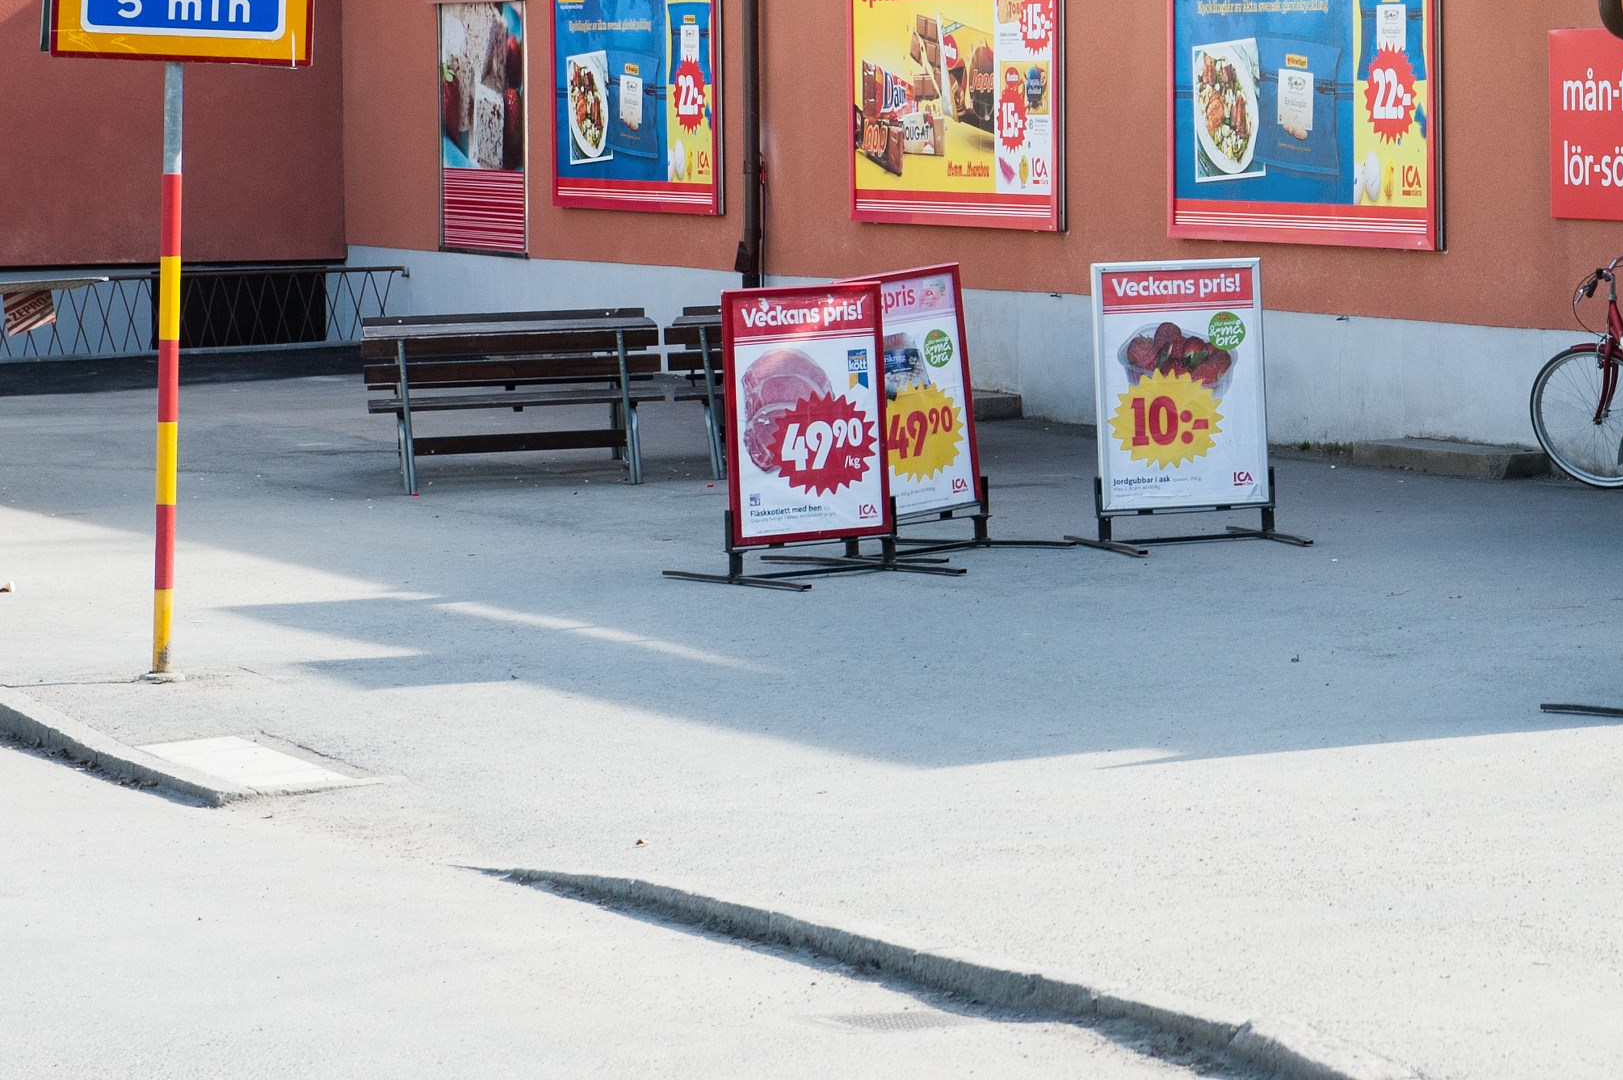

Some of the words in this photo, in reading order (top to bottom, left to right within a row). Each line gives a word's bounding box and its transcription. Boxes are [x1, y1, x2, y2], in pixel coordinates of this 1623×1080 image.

[697, 151, 710, 169] ICA
[1031, 157, 1049, 178] ICA
[1402, 166, 1422, 188] ICA
[1111, 276, 1195, 297] Veckans
[1199, 273, 1241, 298] pris!
[881, 284, 916, 314] pris
[741, 305, 821, 328] Veckans
[823, 300, 863, 327] pris!
[1215, 333, 1239, 346] bra
[848, 359, 867, 370] kött
[1130, 395, 1209, 447] 10:-
[844, 455, 862, 469] /kg
[952, 477, 968, 490] ICA
[1113, 476, 1154, 486] Jordgubbar
[1158, 475, 1171, 483] ask
[1233, 471, 1253, 482] ICA
[791, 505, 807, 514] med
[808, 504, 823, 512] ben
[858, 503, 877, 516] ICA
